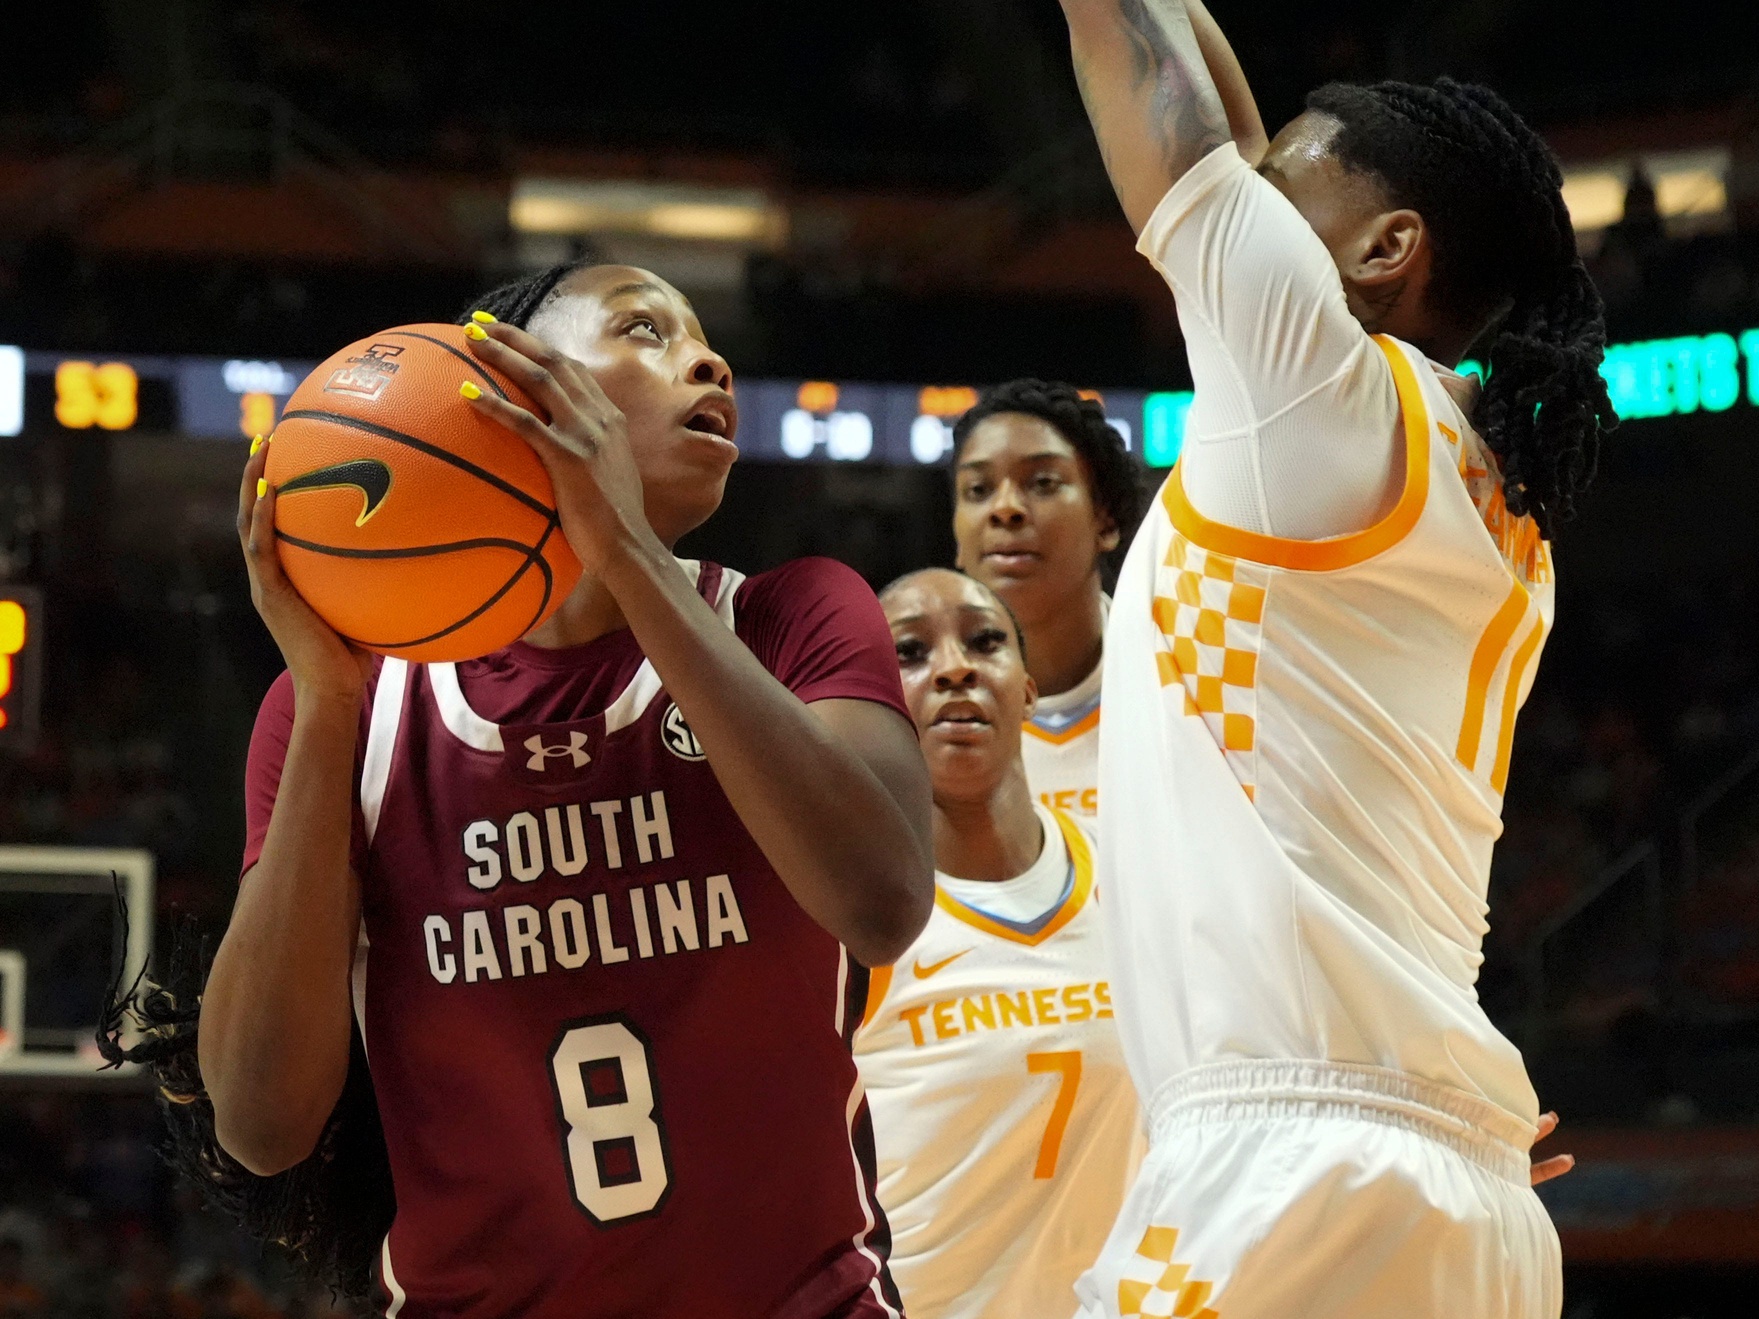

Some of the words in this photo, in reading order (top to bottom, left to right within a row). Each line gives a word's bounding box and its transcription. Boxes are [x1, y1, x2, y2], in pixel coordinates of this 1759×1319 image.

[462, 790, 676, 891] SOUTH
[423, 873, 750, 985] CAROLINA
[549, 1018, 673, 1226] 8
[1027, 1051, 1083, 1181] 7
